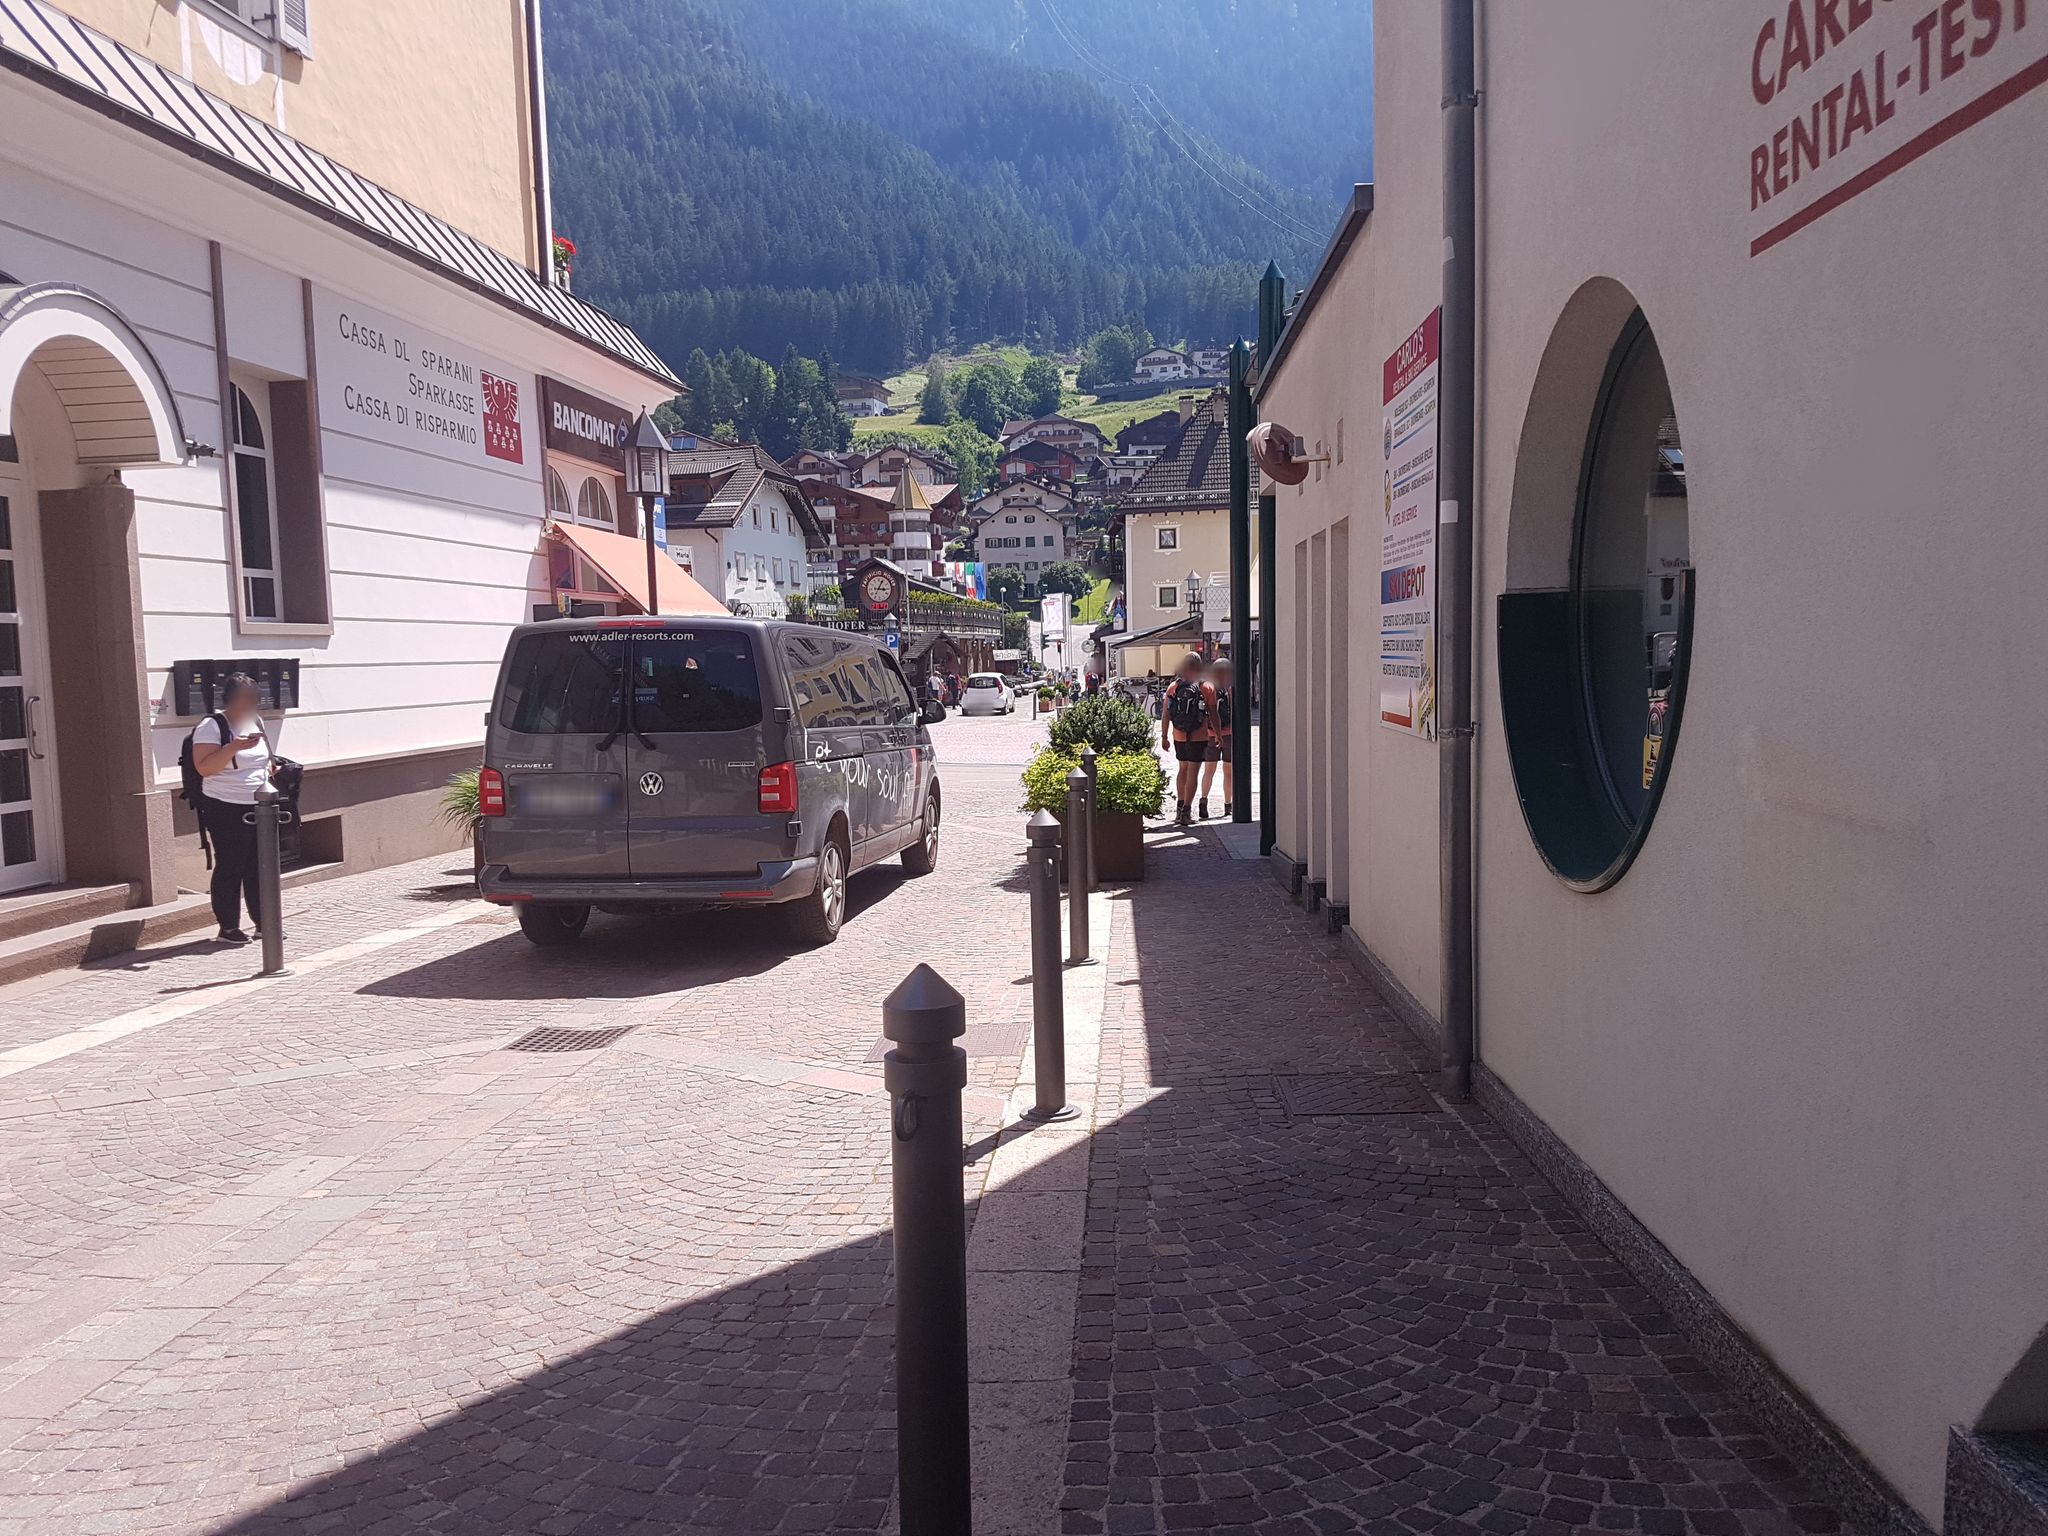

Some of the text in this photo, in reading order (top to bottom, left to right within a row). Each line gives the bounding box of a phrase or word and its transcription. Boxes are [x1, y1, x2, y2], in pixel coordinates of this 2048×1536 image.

[1752, 0, 1893, 105] CAR
[339, 313, 473, 385] CASSA DL SPARANI
[1396, 326, 1425, 374] CARLO'S
[344, 385, 477, 445] CASSA DI RISPARMIO
[408, 373, 475, 415] SPARKASSE
[553, 401, 616, 448] BANCOMAT
[1401, 565, 1427, 599] DEPOT
[569, 632, 694, 643] www.adler-resorts.com
[828, 620, 866, 630] HOFER
[886, 634, 896, 647] P
[805, 728, 832, 773] Let
